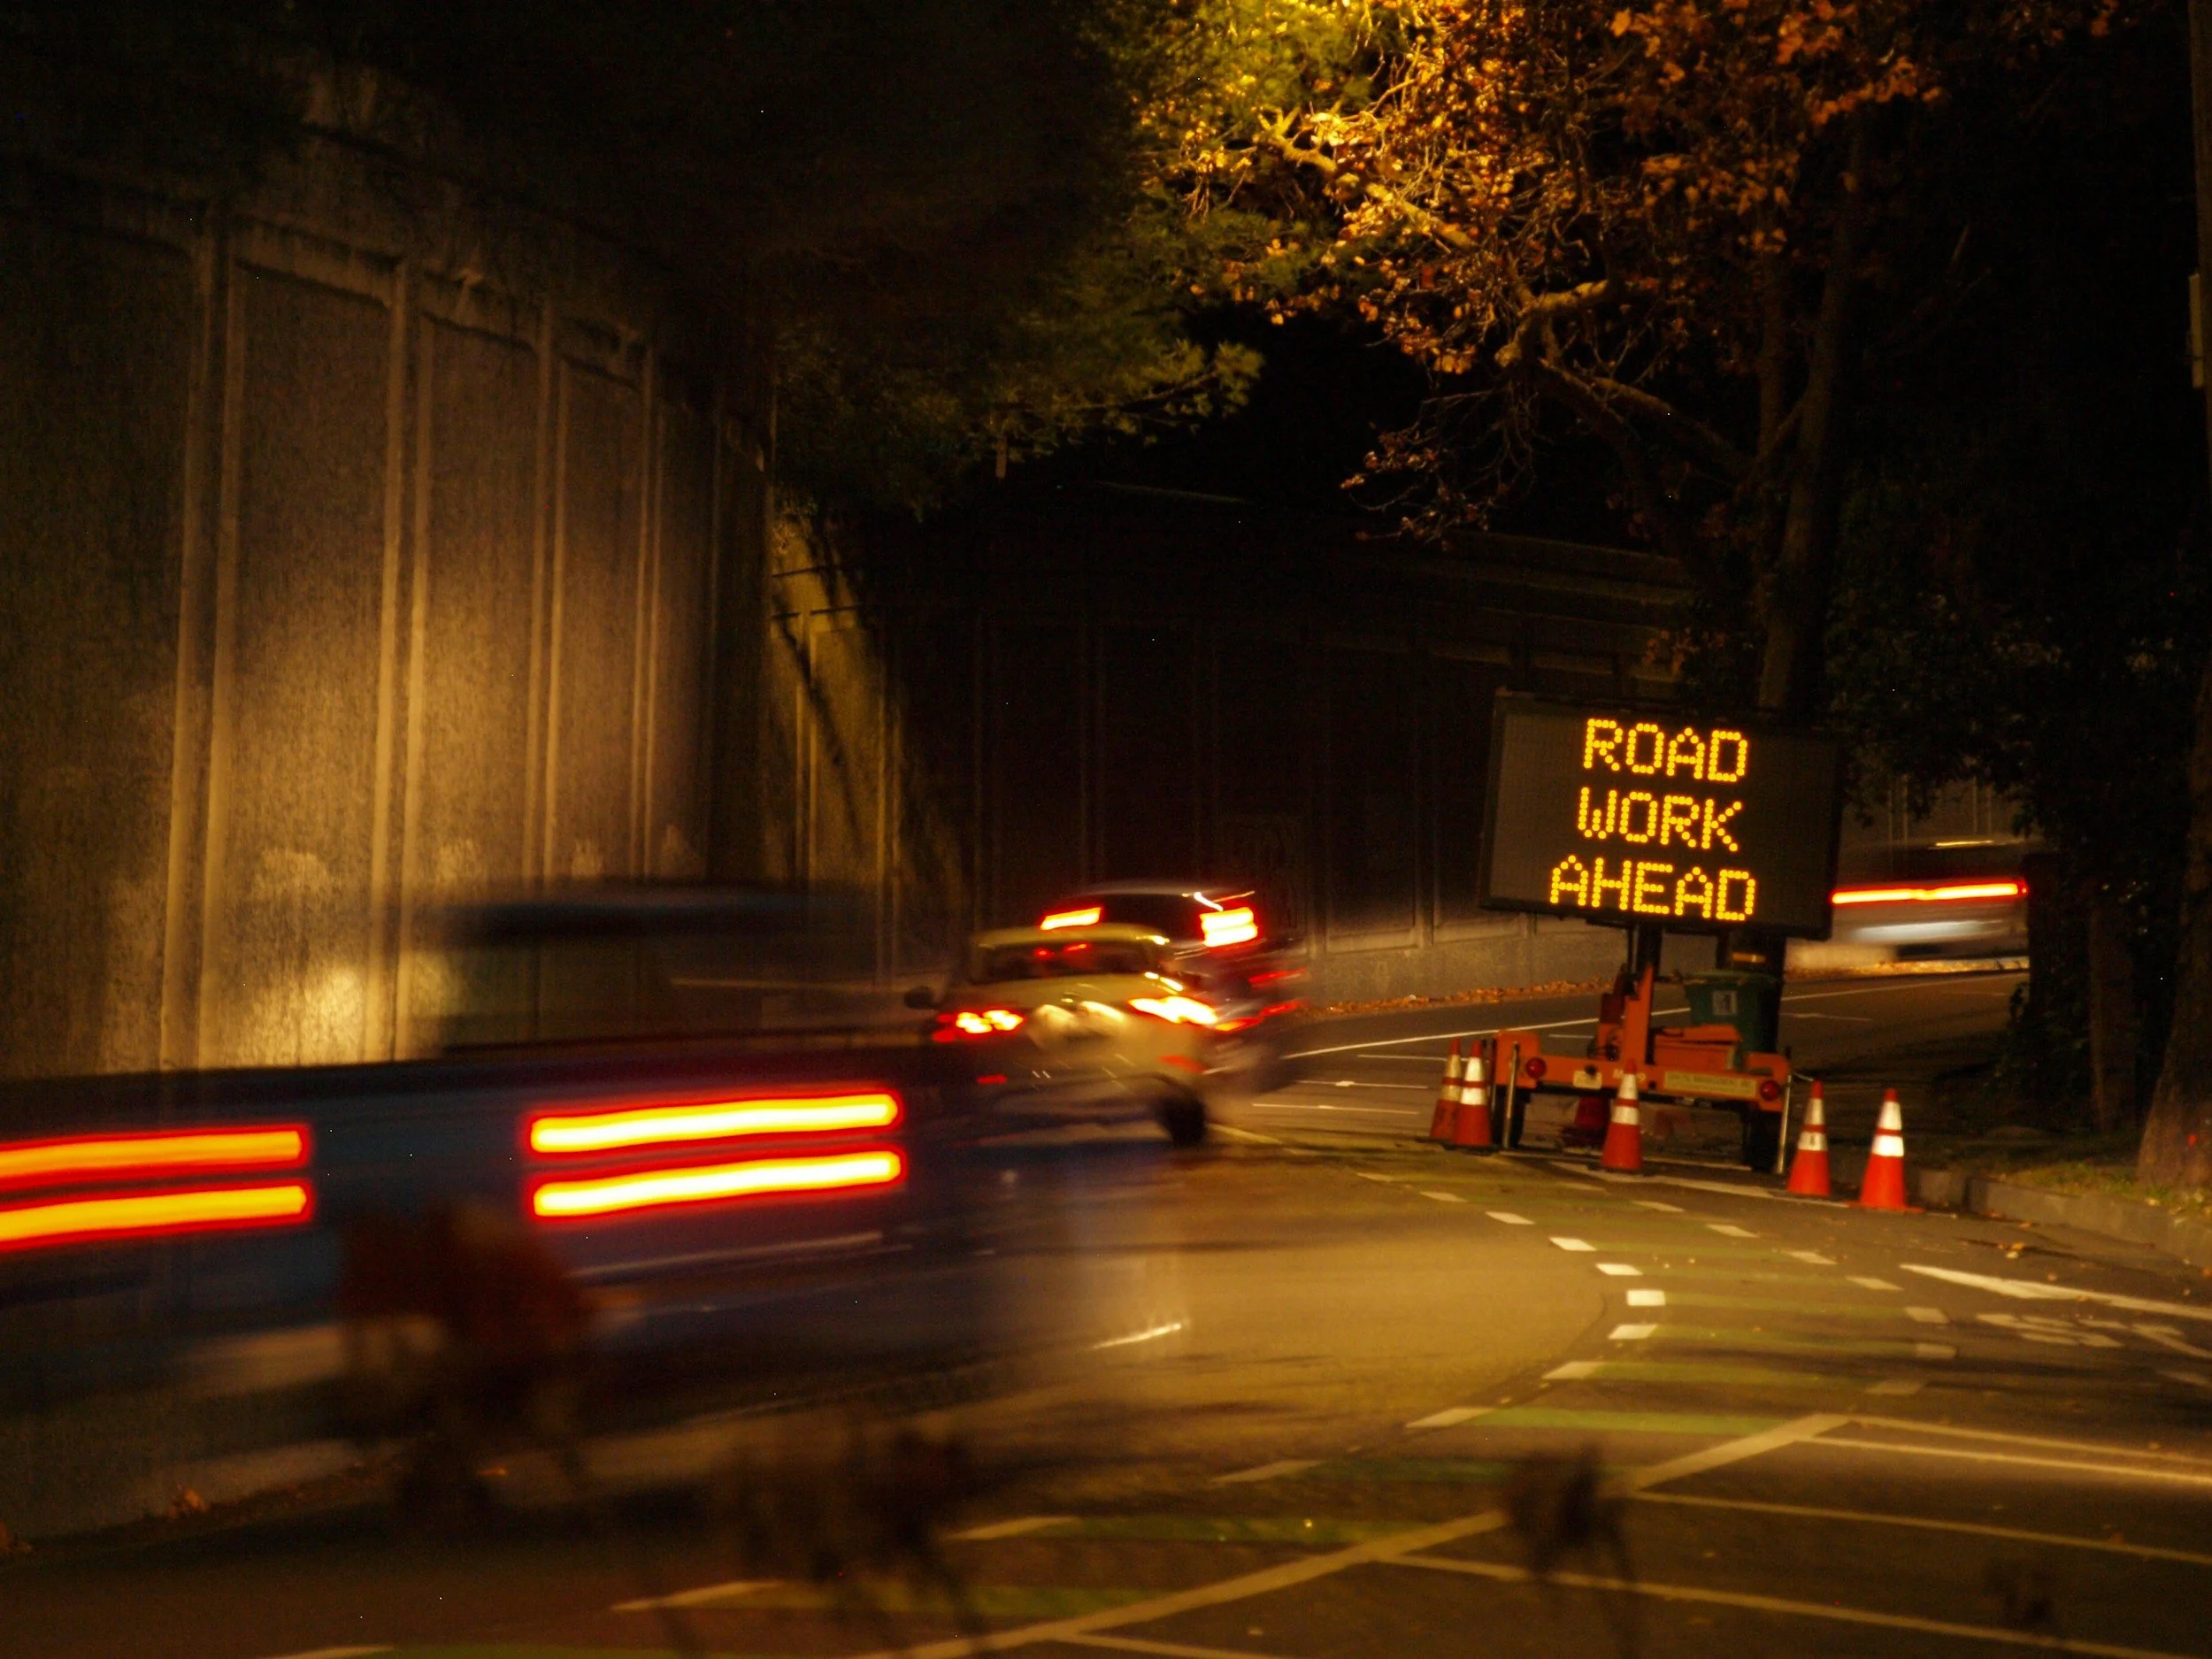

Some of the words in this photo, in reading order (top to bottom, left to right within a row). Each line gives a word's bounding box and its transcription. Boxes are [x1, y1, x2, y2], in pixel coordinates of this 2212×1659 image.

[1582, 718, 1748, 782] ROAD
[1577, 787, 1742, 852] WORK
[1549, 854, 1756, 921] AHEAD
